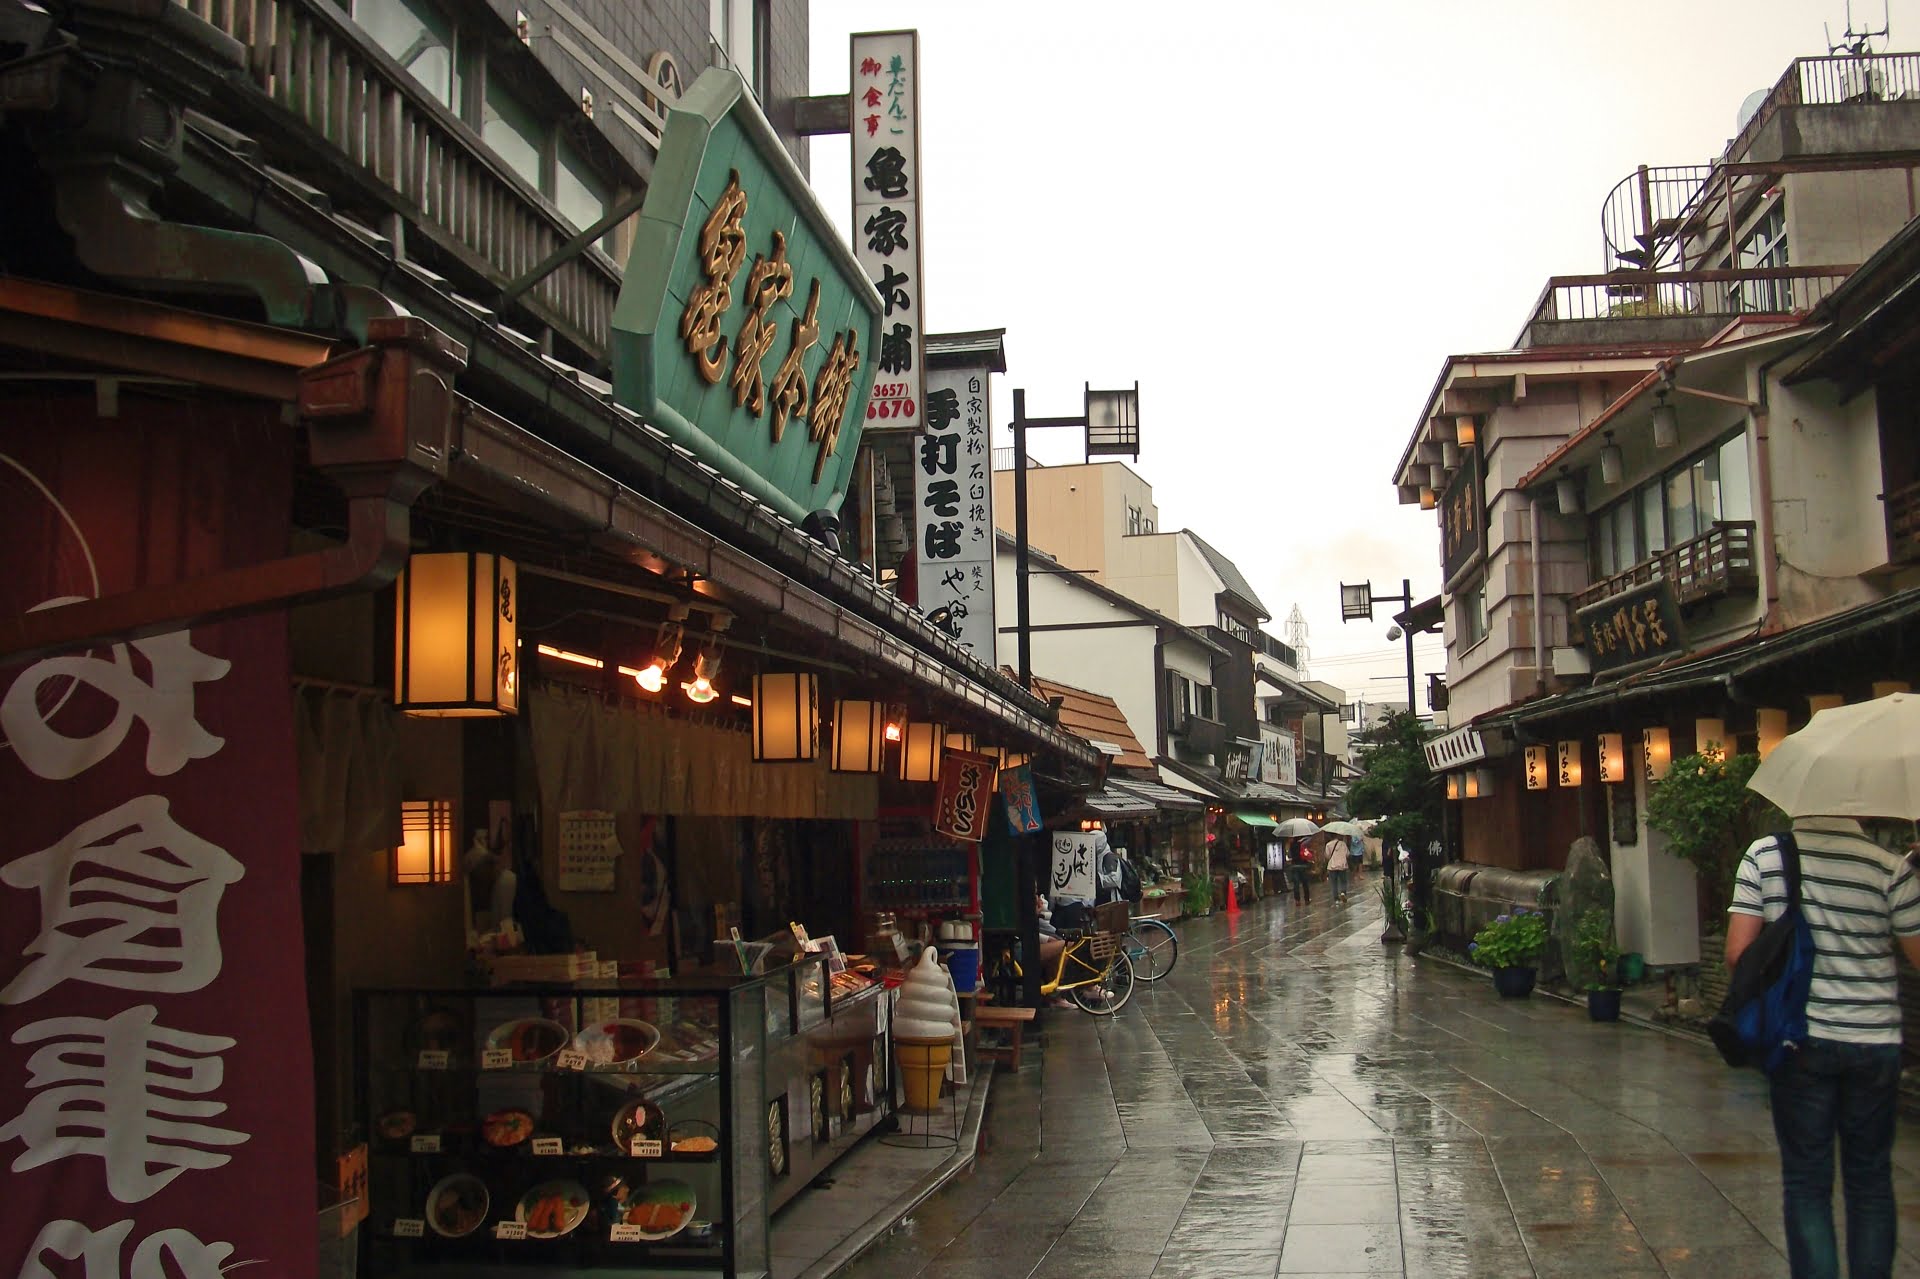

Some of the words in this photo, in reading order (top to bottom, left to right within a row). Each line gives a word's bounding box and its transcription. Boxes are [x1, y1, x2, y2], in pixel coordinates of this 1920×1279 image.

[860, 56, 883, 137] 御食事
[886, 55, 907, 135] 草だんご
[967, 376, 986, 456] 自家製粉
[921, 388, 964, 559] 手打そば
[968, 464, 986, 541] 石臼挽き
[971, 565, 985, 591] 柴又
[499, 577, 513, 690] 亀家
[1526, 748, 1539, 787] 川千家
[1559, 742, 1571, 783] 川千家
[1599, 735, 1609, 779] 川千家
[1052, 858, 1073, 891] うどん
[1073, 842, 1089, 878] そば
